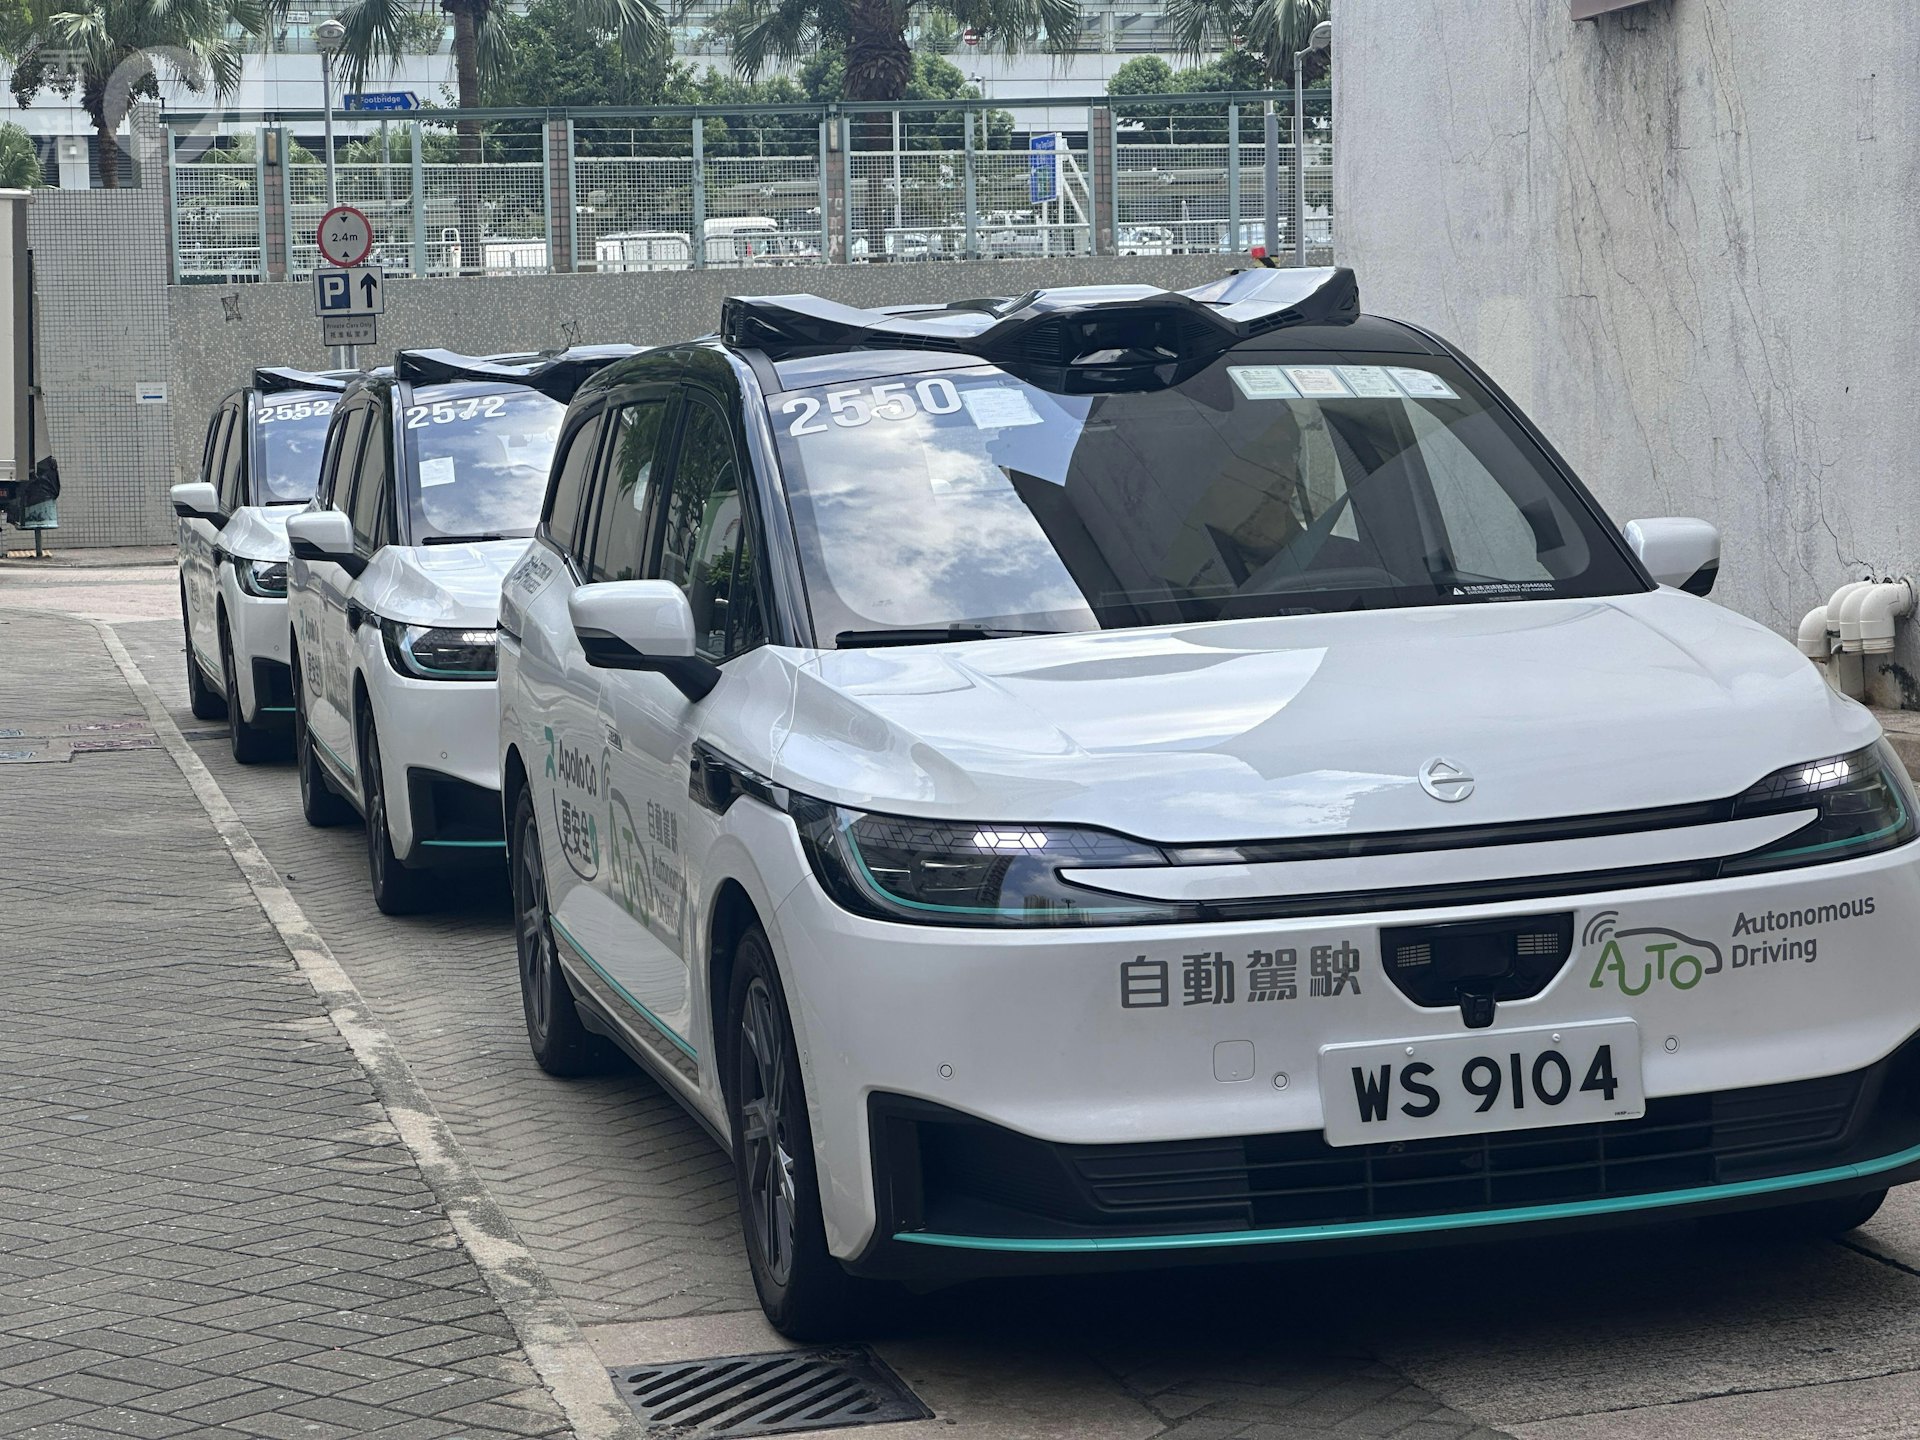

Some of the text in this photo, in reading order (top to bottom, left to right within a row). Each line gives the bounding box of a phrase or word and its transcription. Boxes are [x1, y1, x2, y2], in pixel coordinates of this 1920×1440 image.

[361, 94, 401, 104] Footbridge
[332, 233, 358, 242] 2.4m
[323, 276, 345, 307] P
[257, 400, 332, 424] 2552
[406, 396, 507, 429] 2572
[782, 378, 963, 437] 2550
[559, 739, 585, 789] Apollo
[562, 799, 592, 865] 更安全
[1732, 897, 1876, 937] Autonomous
[1732, 938, 1817, 969] Driving
[1120, 940, 1362, 1009] 自動駕駛
[1352, 1044, 1618, 1123] WS 9104
